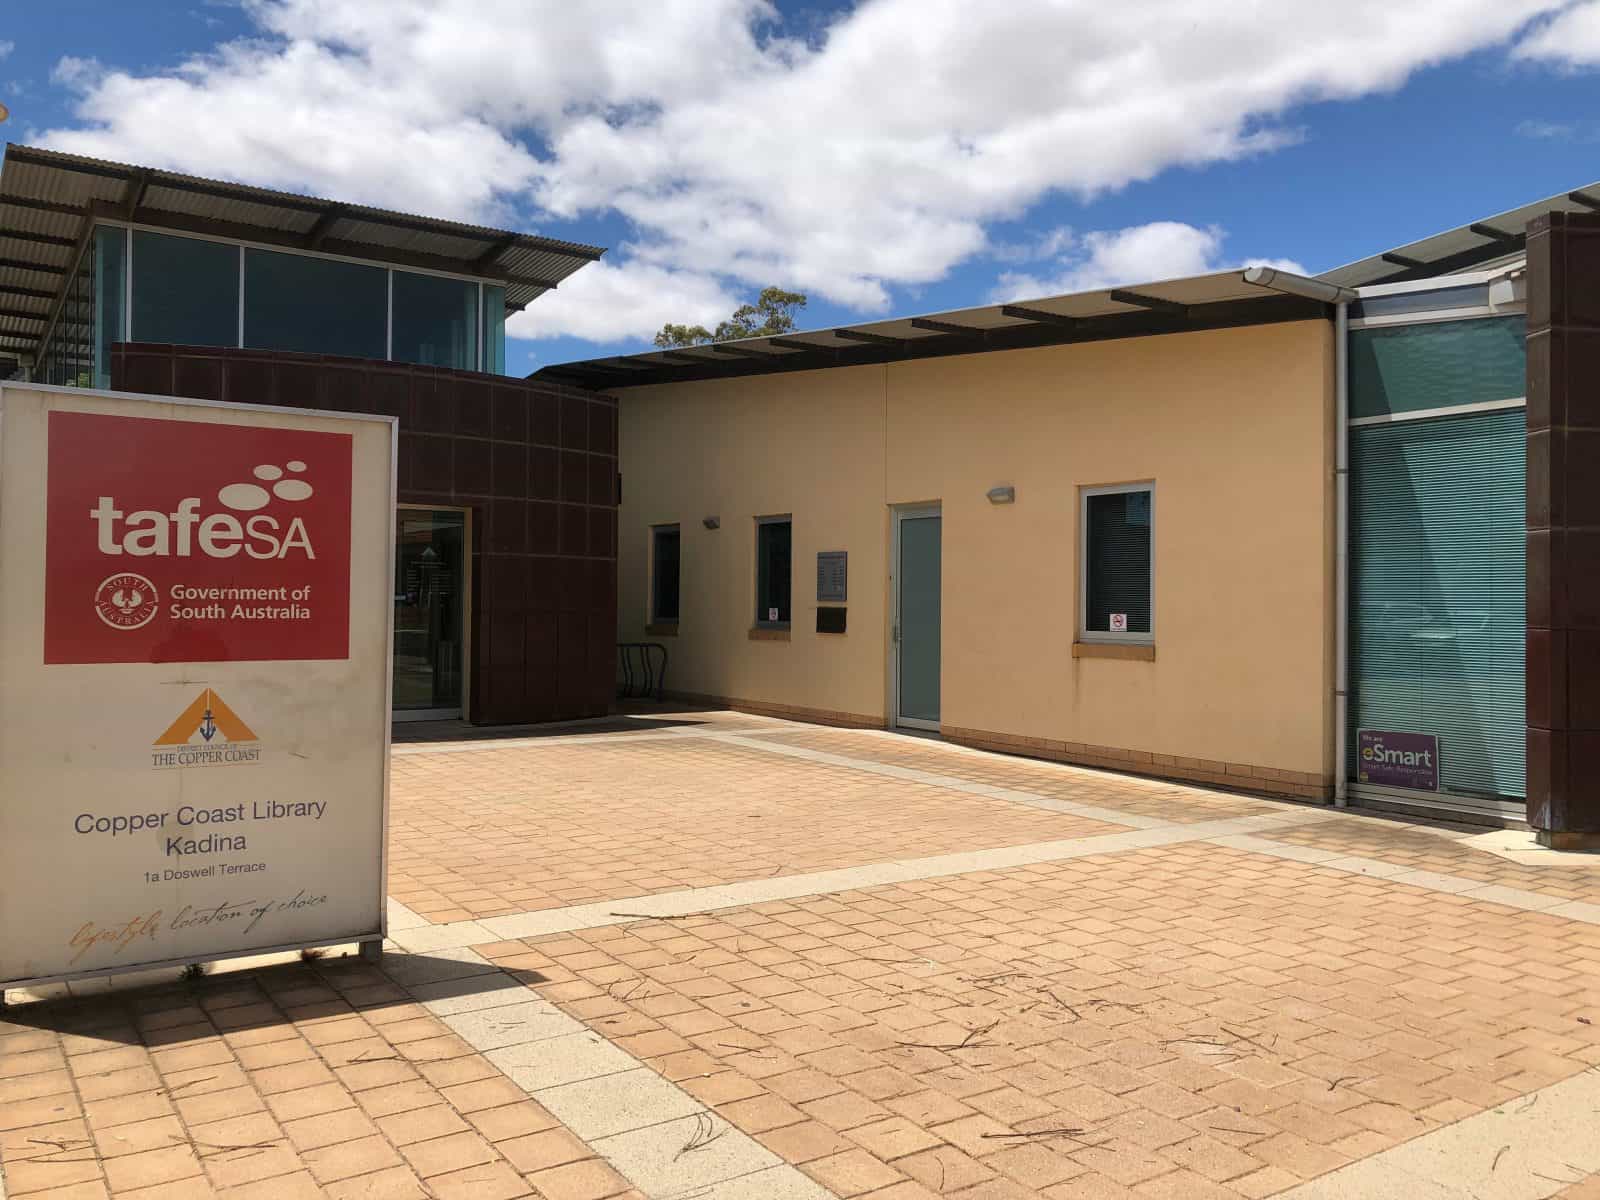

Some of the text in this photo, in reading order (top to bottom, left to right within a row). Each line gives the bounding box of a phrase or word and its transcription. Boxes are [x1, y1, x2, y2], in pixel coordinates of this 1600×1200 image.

[90, 496, 316, 560] tafeSA
[106, 576, 149, 593] SOUTH
[170, 584, 311, 601] Government of
[170, 602, 311, 620] South Australia
[151, 752, 177, 766] THE
[178, 750, 223, 766] COPPER
[224, 748, 262, 762] COAST
[1362, 743, 1432, 769] eSmart
[74, 800, 327, 837] Copper Coast Library
[165, 833, 247, 857] Kadina
[144, 860, 267, 884] 1a Doswell Terrace
[170, 900, 248, 929] location
[243, 900, 275, 935] of
[277, 889, 328, 911] choice
